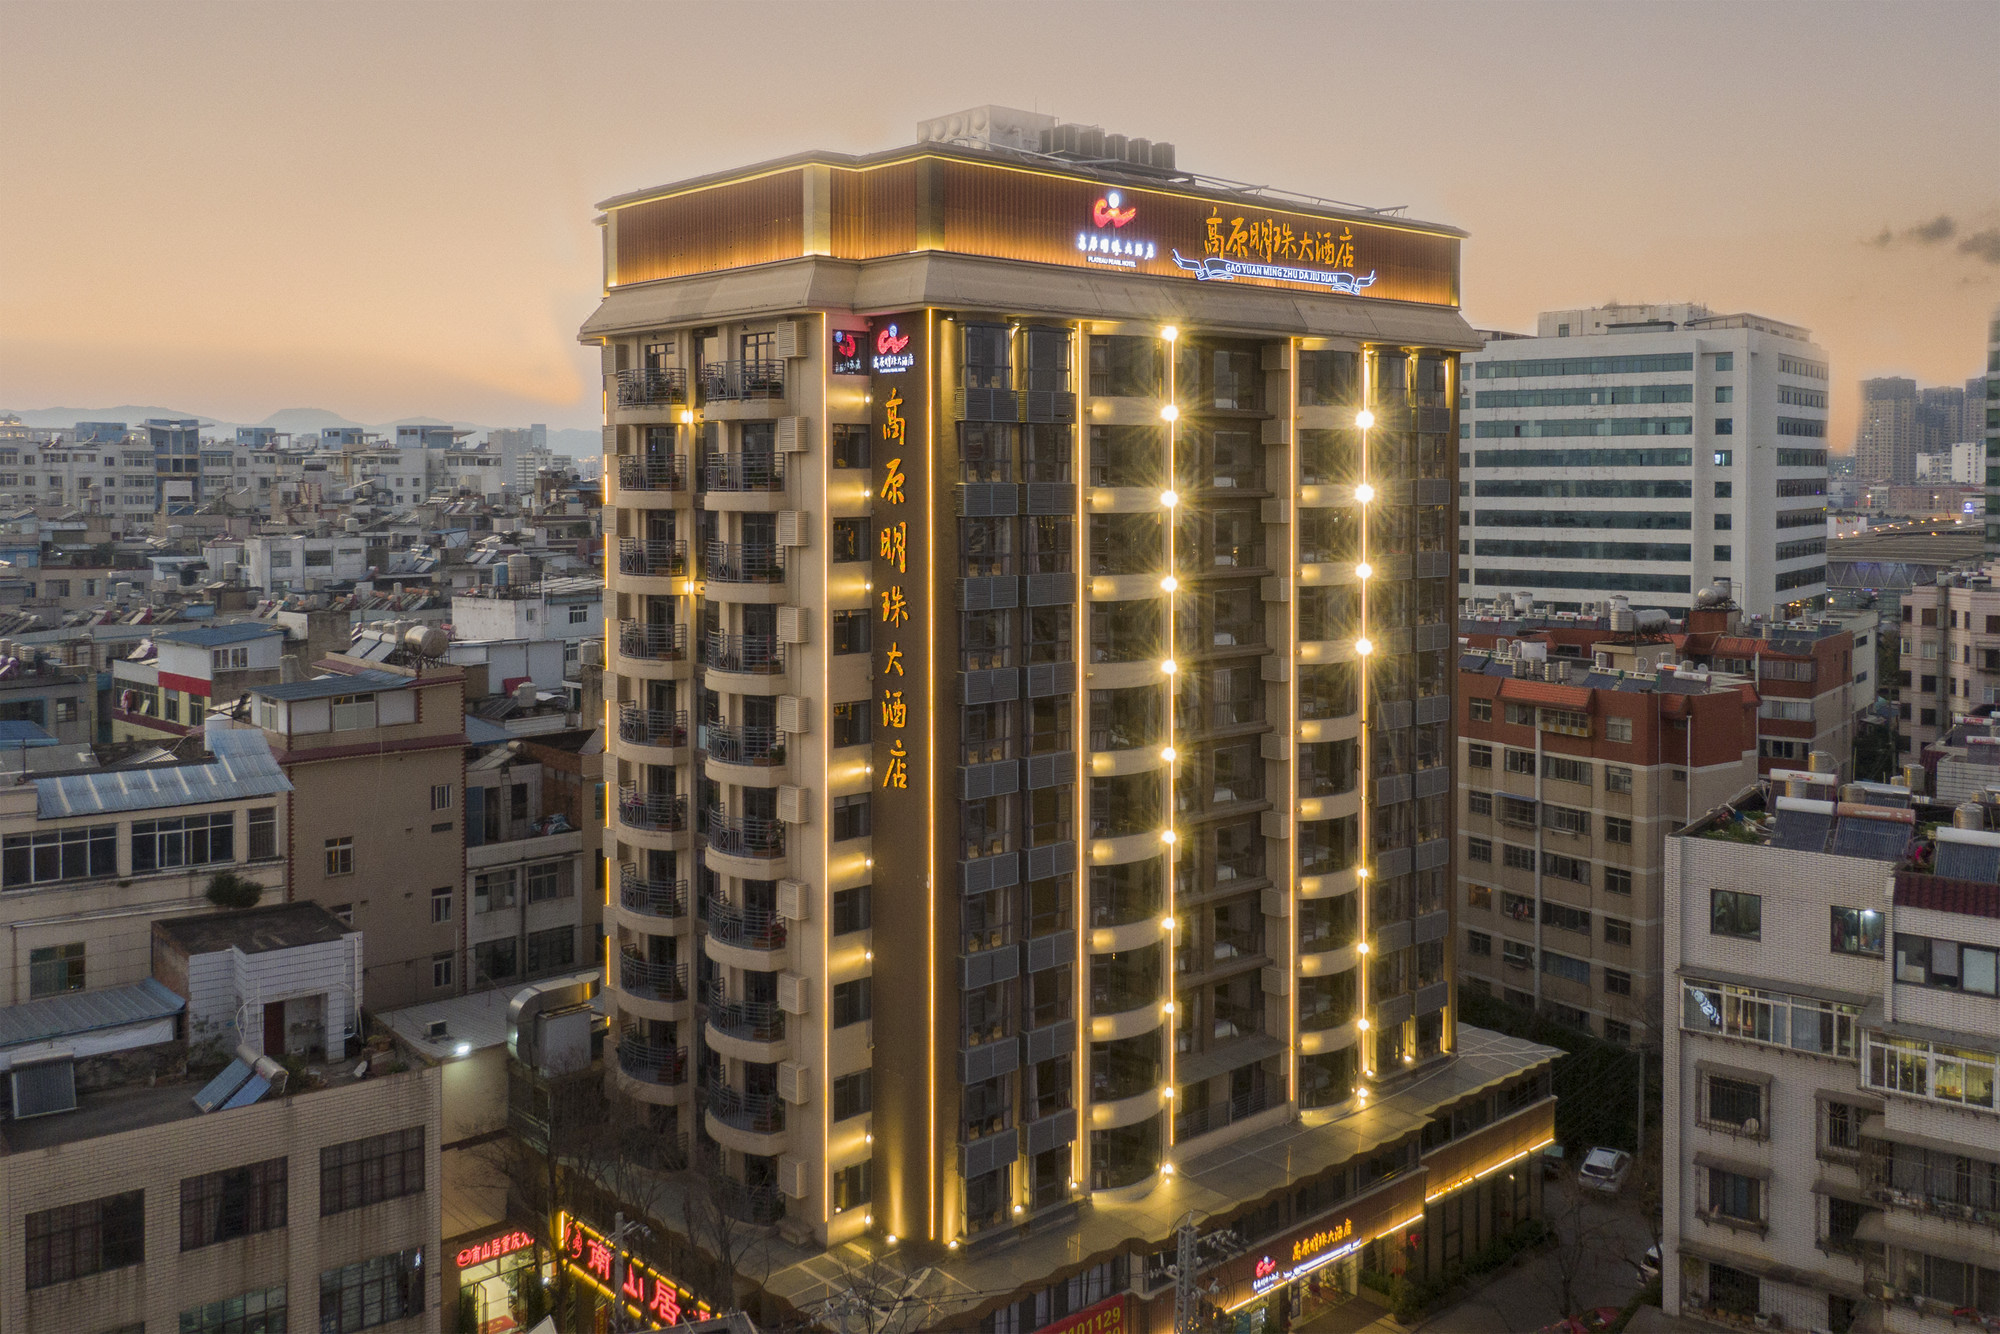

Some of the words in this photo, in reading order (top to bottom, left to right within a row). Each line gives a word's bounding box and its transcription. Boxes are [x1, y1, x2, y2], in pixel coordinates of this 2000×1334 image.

[1204, 206, 1354, 268] 高原明珠大酒店
[1225, 263, 1241, 273] GAO
[1242, 264, 1262, 276] YUAN
[1263, 266, 1282, 278] MING
[1283, 269, 1298, 279] ZHU
[1299, 271, 1309, 281] DA
[1309, 272, 1320, 282] JIU
[1320, 273, 1338, 283] DIAN
[880, 388, 909, 789] 高原明珠大酒店
